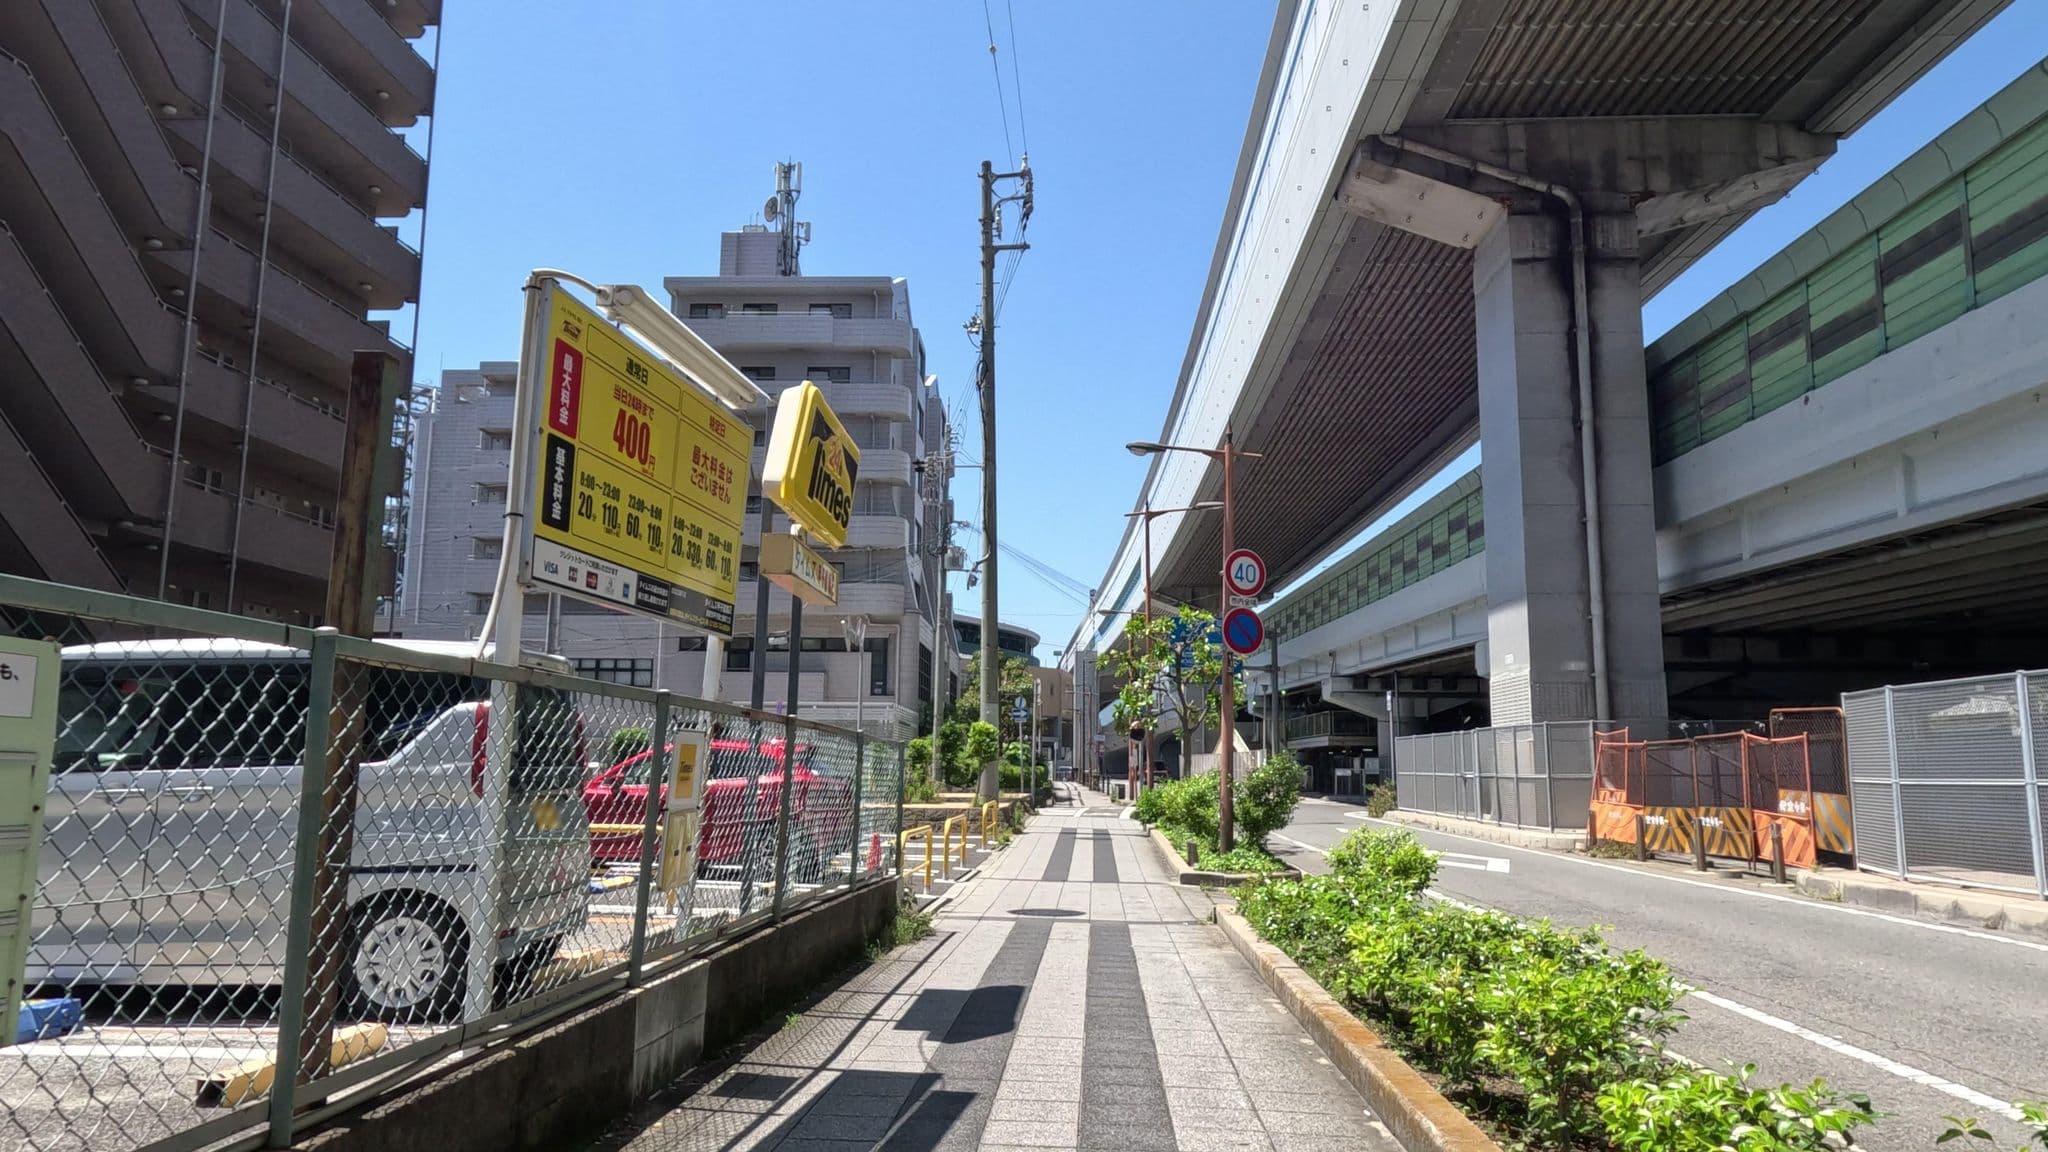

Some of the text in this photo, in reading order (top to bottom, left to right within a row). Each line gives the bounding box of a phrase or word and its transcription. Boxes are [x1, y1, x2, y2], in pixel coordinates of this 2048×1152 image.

[692, 444, 733, 484] 最大料金は
[690, 466, 732, 505] ございません
[543, 559, 559, 575] VISA
[1234, 563, 1257, 583] 40
